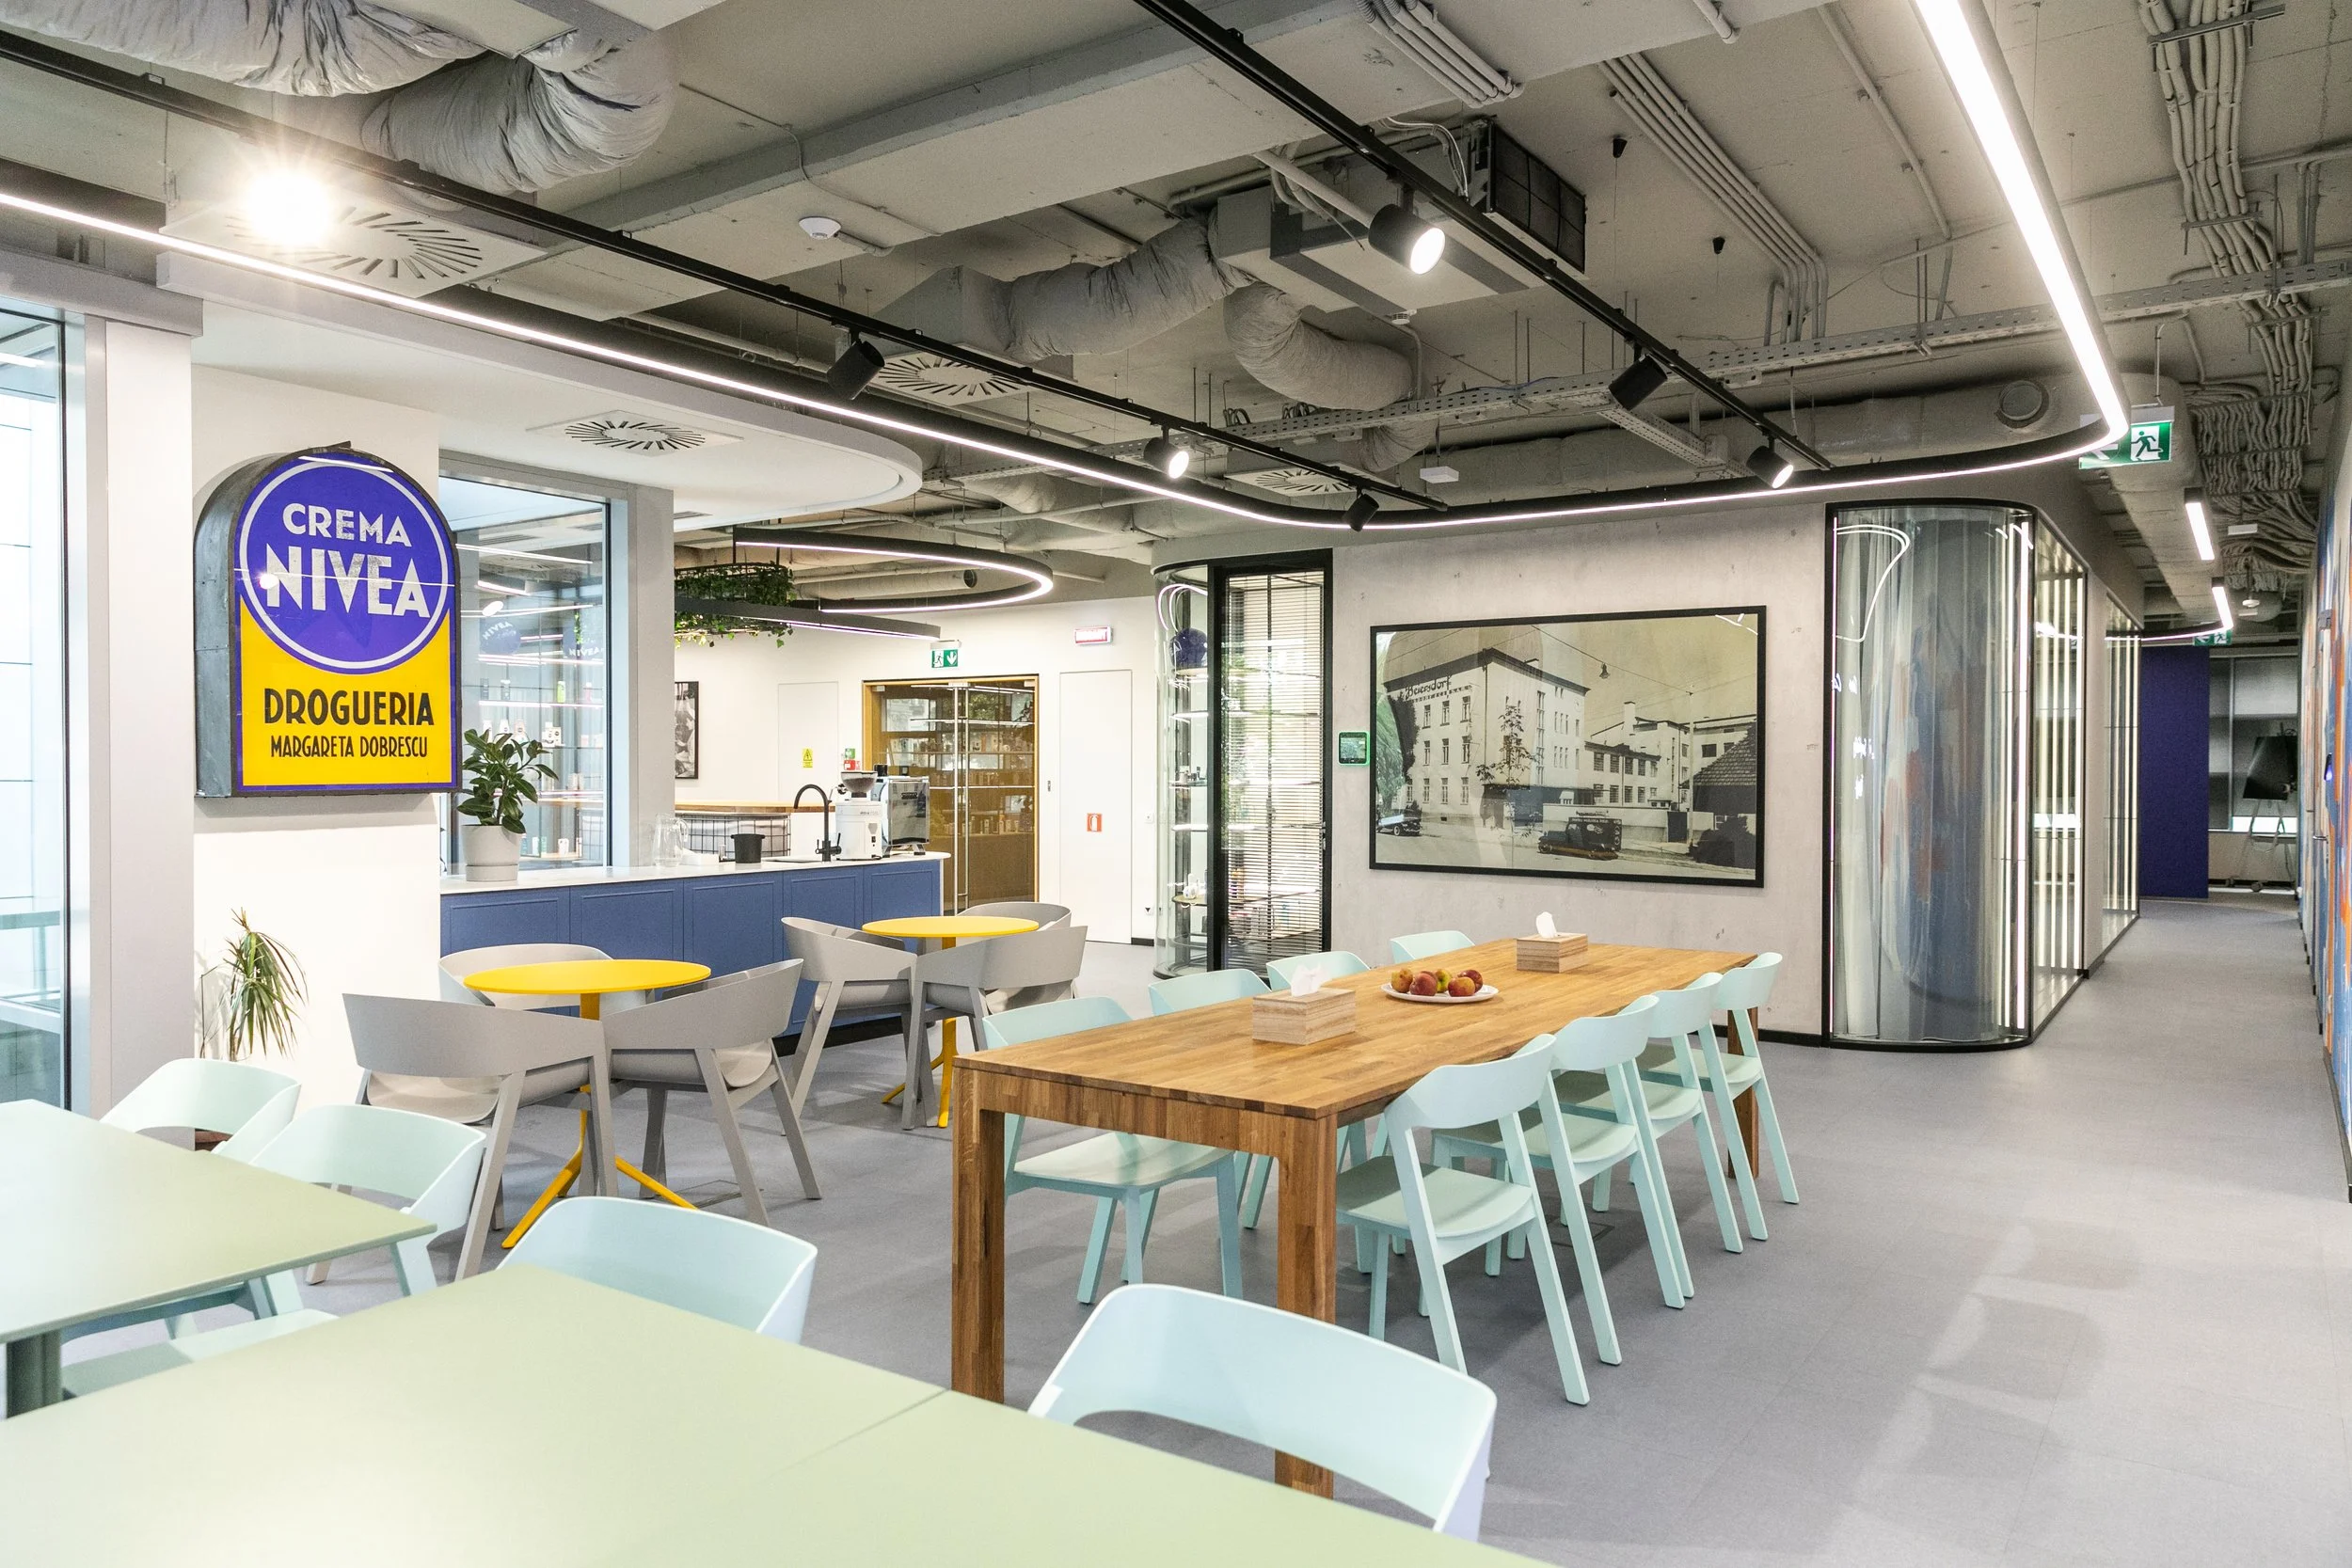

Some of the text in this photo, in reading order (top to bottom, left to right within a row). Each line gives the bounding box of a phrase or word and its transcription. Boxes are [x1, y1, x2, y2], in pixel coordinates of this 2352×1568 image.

[282, 502, 412, 547] CREMA
[266, 543, 431, 619] NIVEA
[264, 688, 435, 726] DROGUERIA
[271, 736, 428, 758] MARGARETA DOBRESCU
